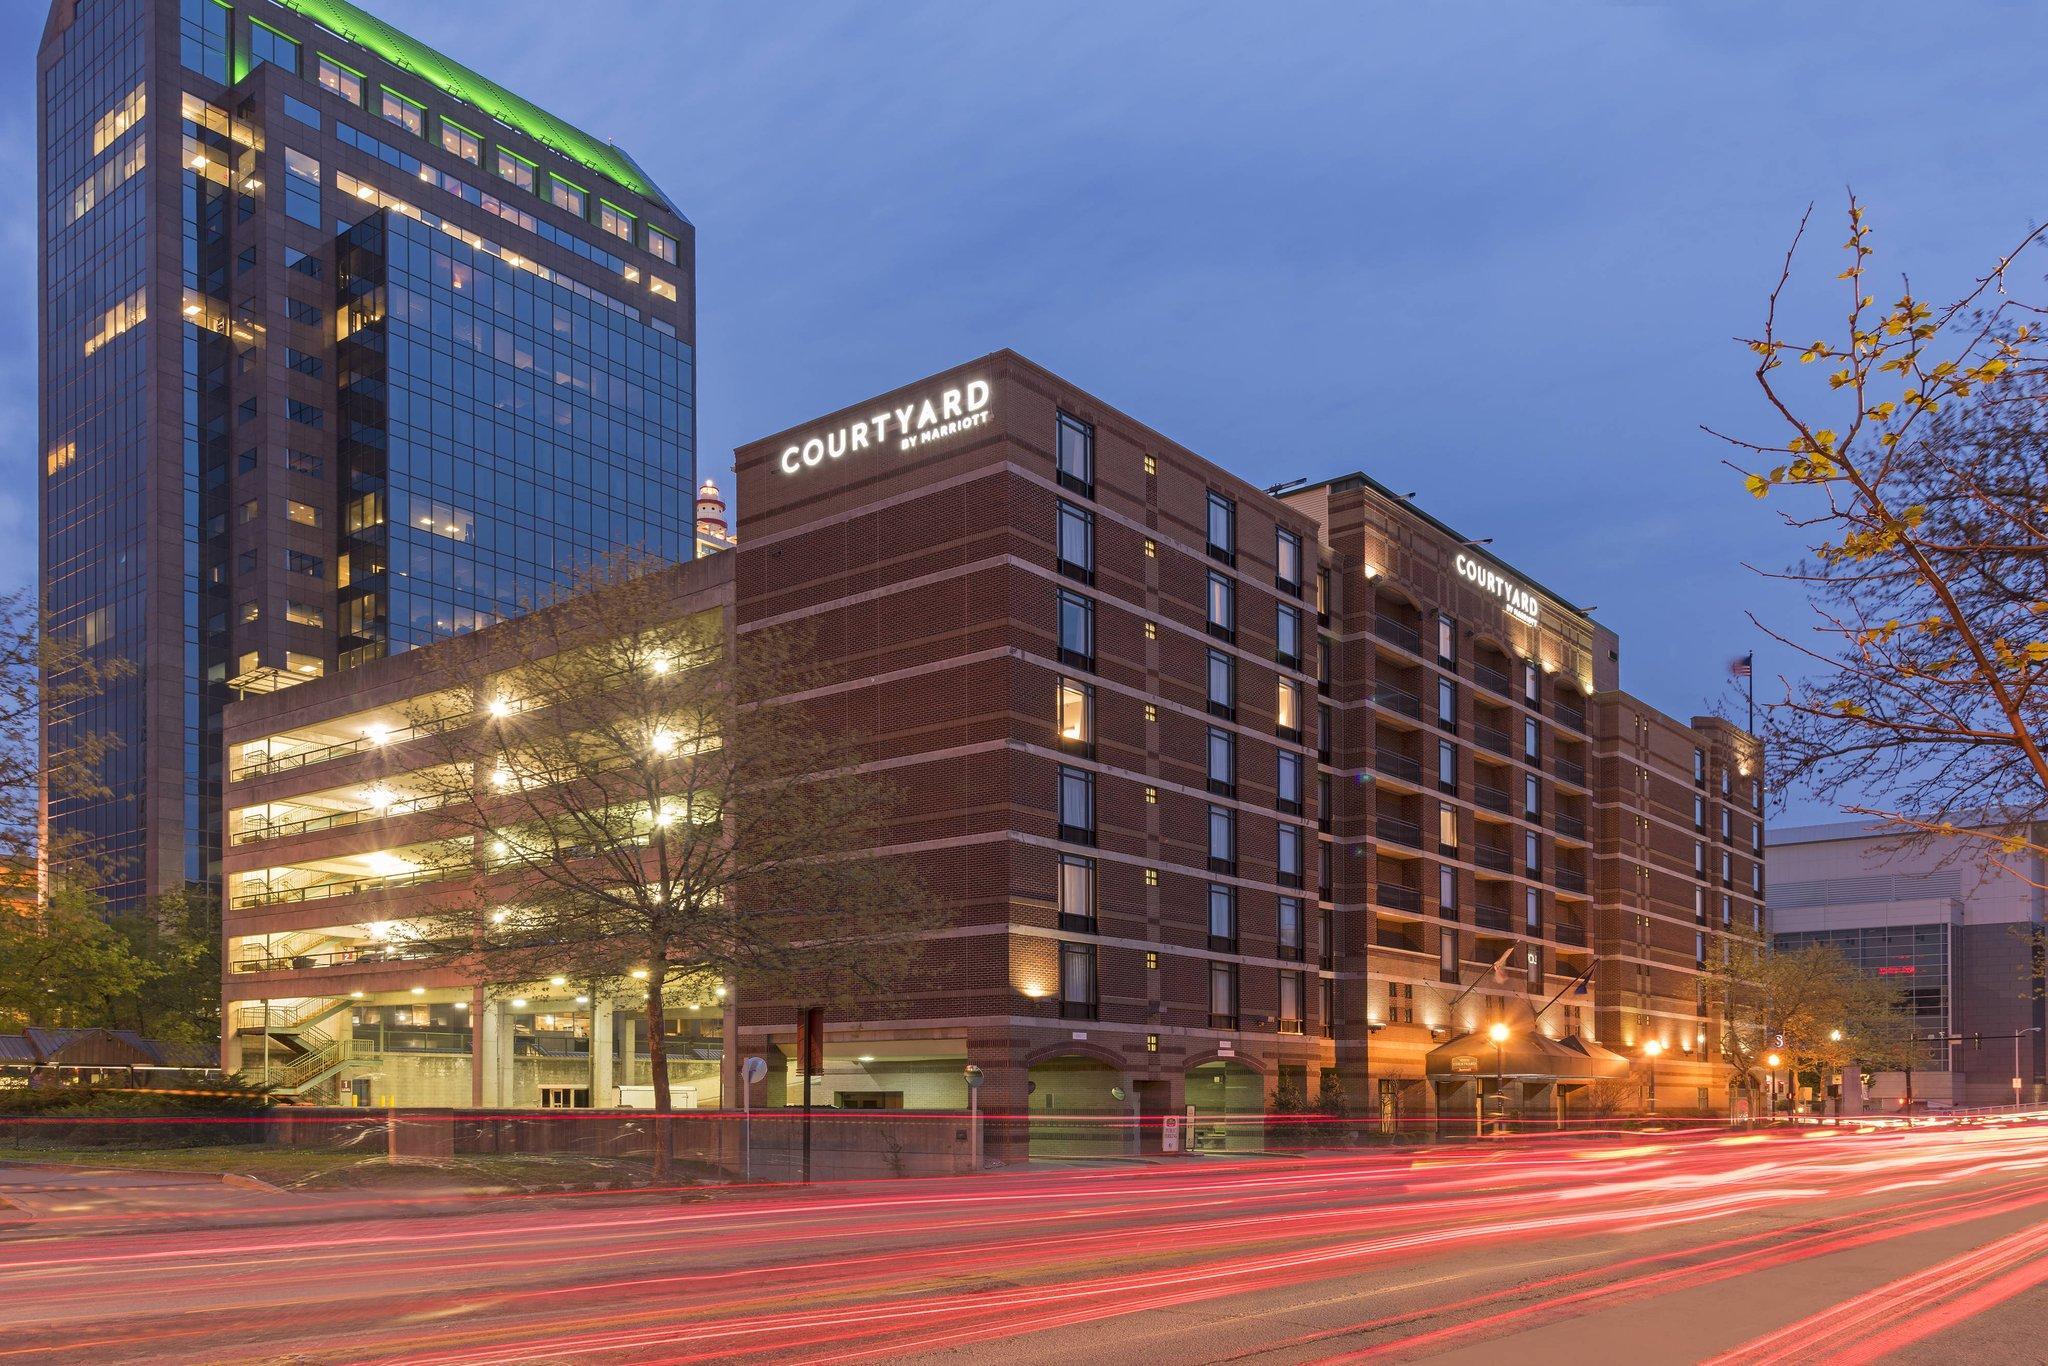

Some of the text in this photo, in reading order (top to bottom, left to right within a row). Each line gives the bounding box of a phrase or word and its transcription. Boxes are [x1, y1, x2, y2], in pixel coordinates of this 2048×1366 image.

[781, 379, 990, 474] COURTYARD
[901, 410, 990, 450] BY MARRIOTT
[1456, 554, 1538, 617] COURTYARD
